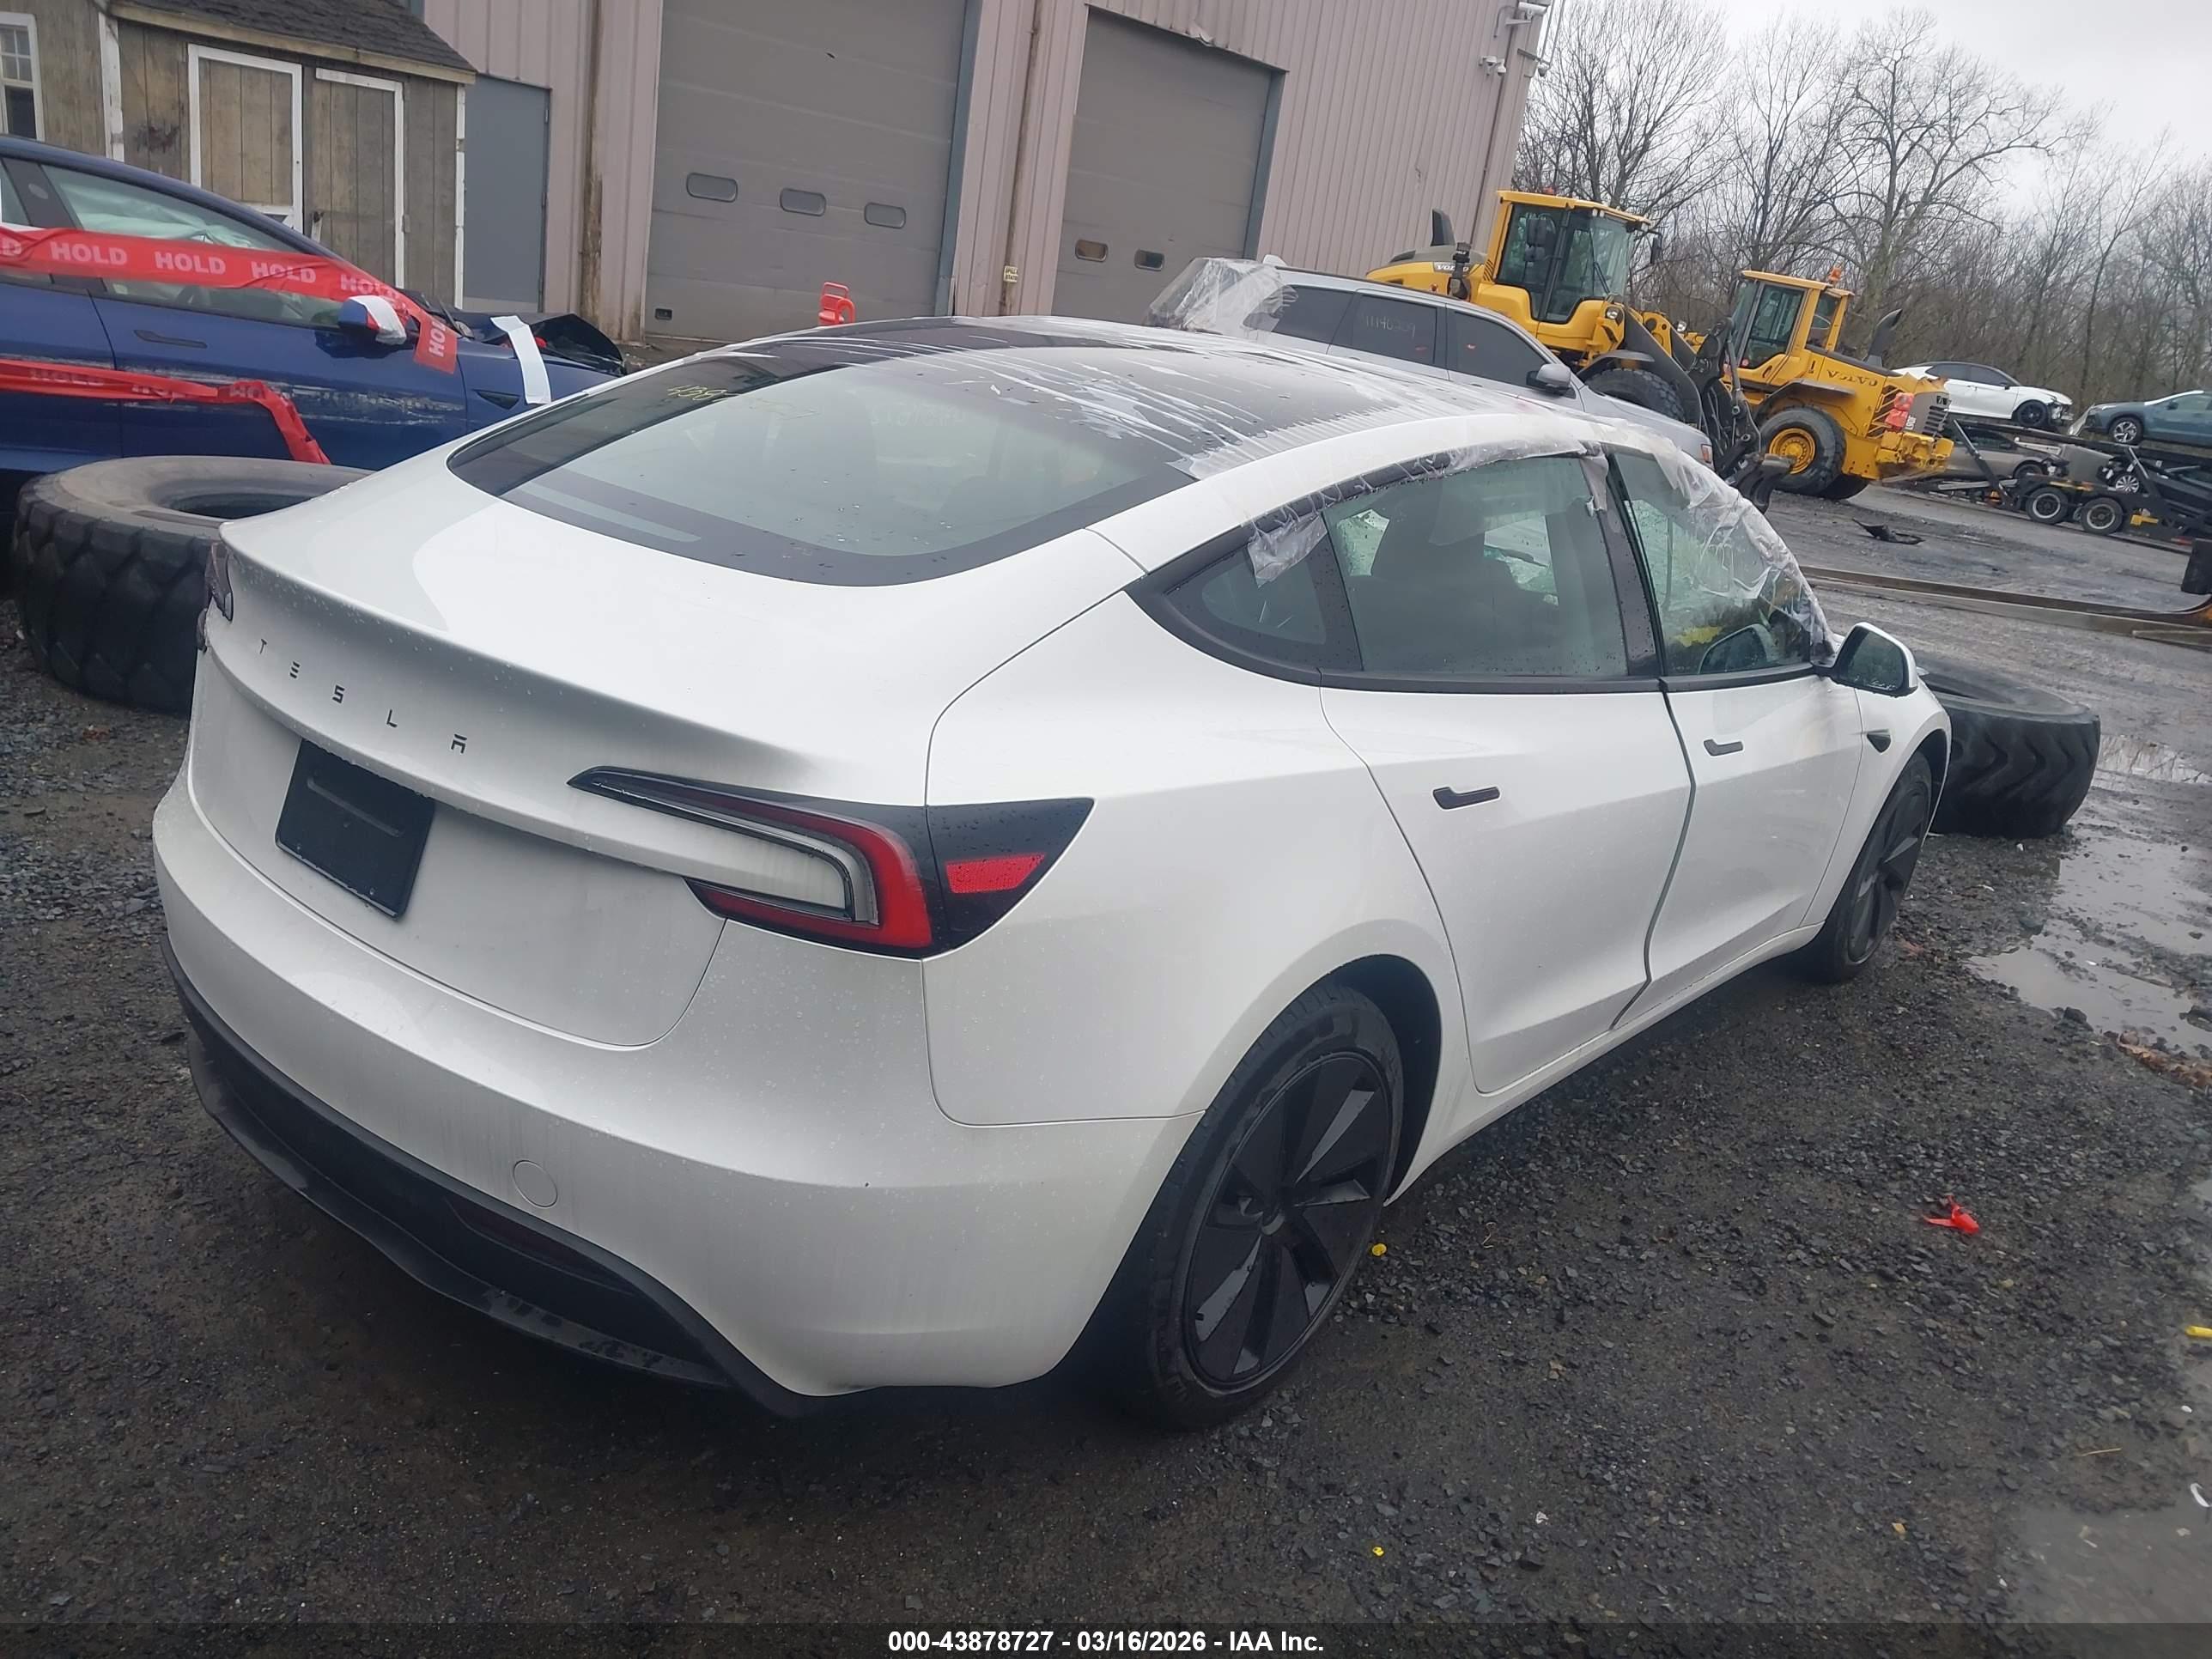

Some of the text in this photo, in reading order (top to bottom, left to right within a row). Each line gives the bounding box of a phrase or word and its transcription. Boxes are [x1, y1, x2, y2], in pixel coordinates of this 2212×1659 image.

[49, 240, 128, 265] HOLD
[155, 251, 226, 275] HOLD
[250, 260, 317, 283] HOLD
[1436, 264, 1469, 272] VOLO
[259, 638, 468, 755] TESLA
